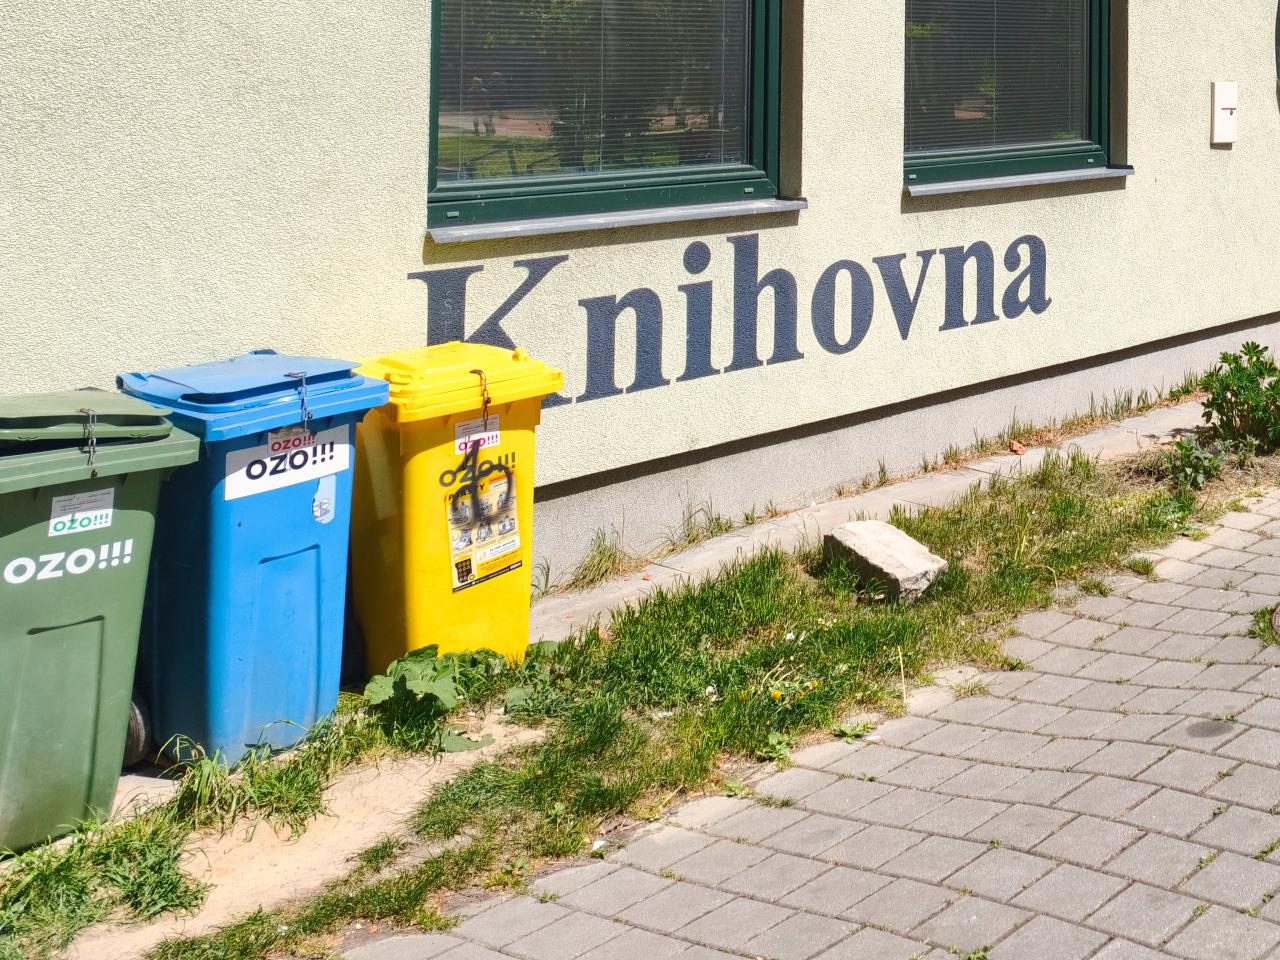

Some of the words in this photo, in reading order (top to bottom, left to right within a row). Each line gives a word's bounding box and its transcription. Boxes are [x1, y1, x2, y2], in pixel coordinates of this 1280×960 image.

[407, 233, 1053, 409] Knihovna
[245, 440, 336, 480] OZO!!!
[271, 431, 317, 452] OZO!!!
[53, 512, 109, 532] OZO!!!
[3, 538, 134, 584] OZO!!!
